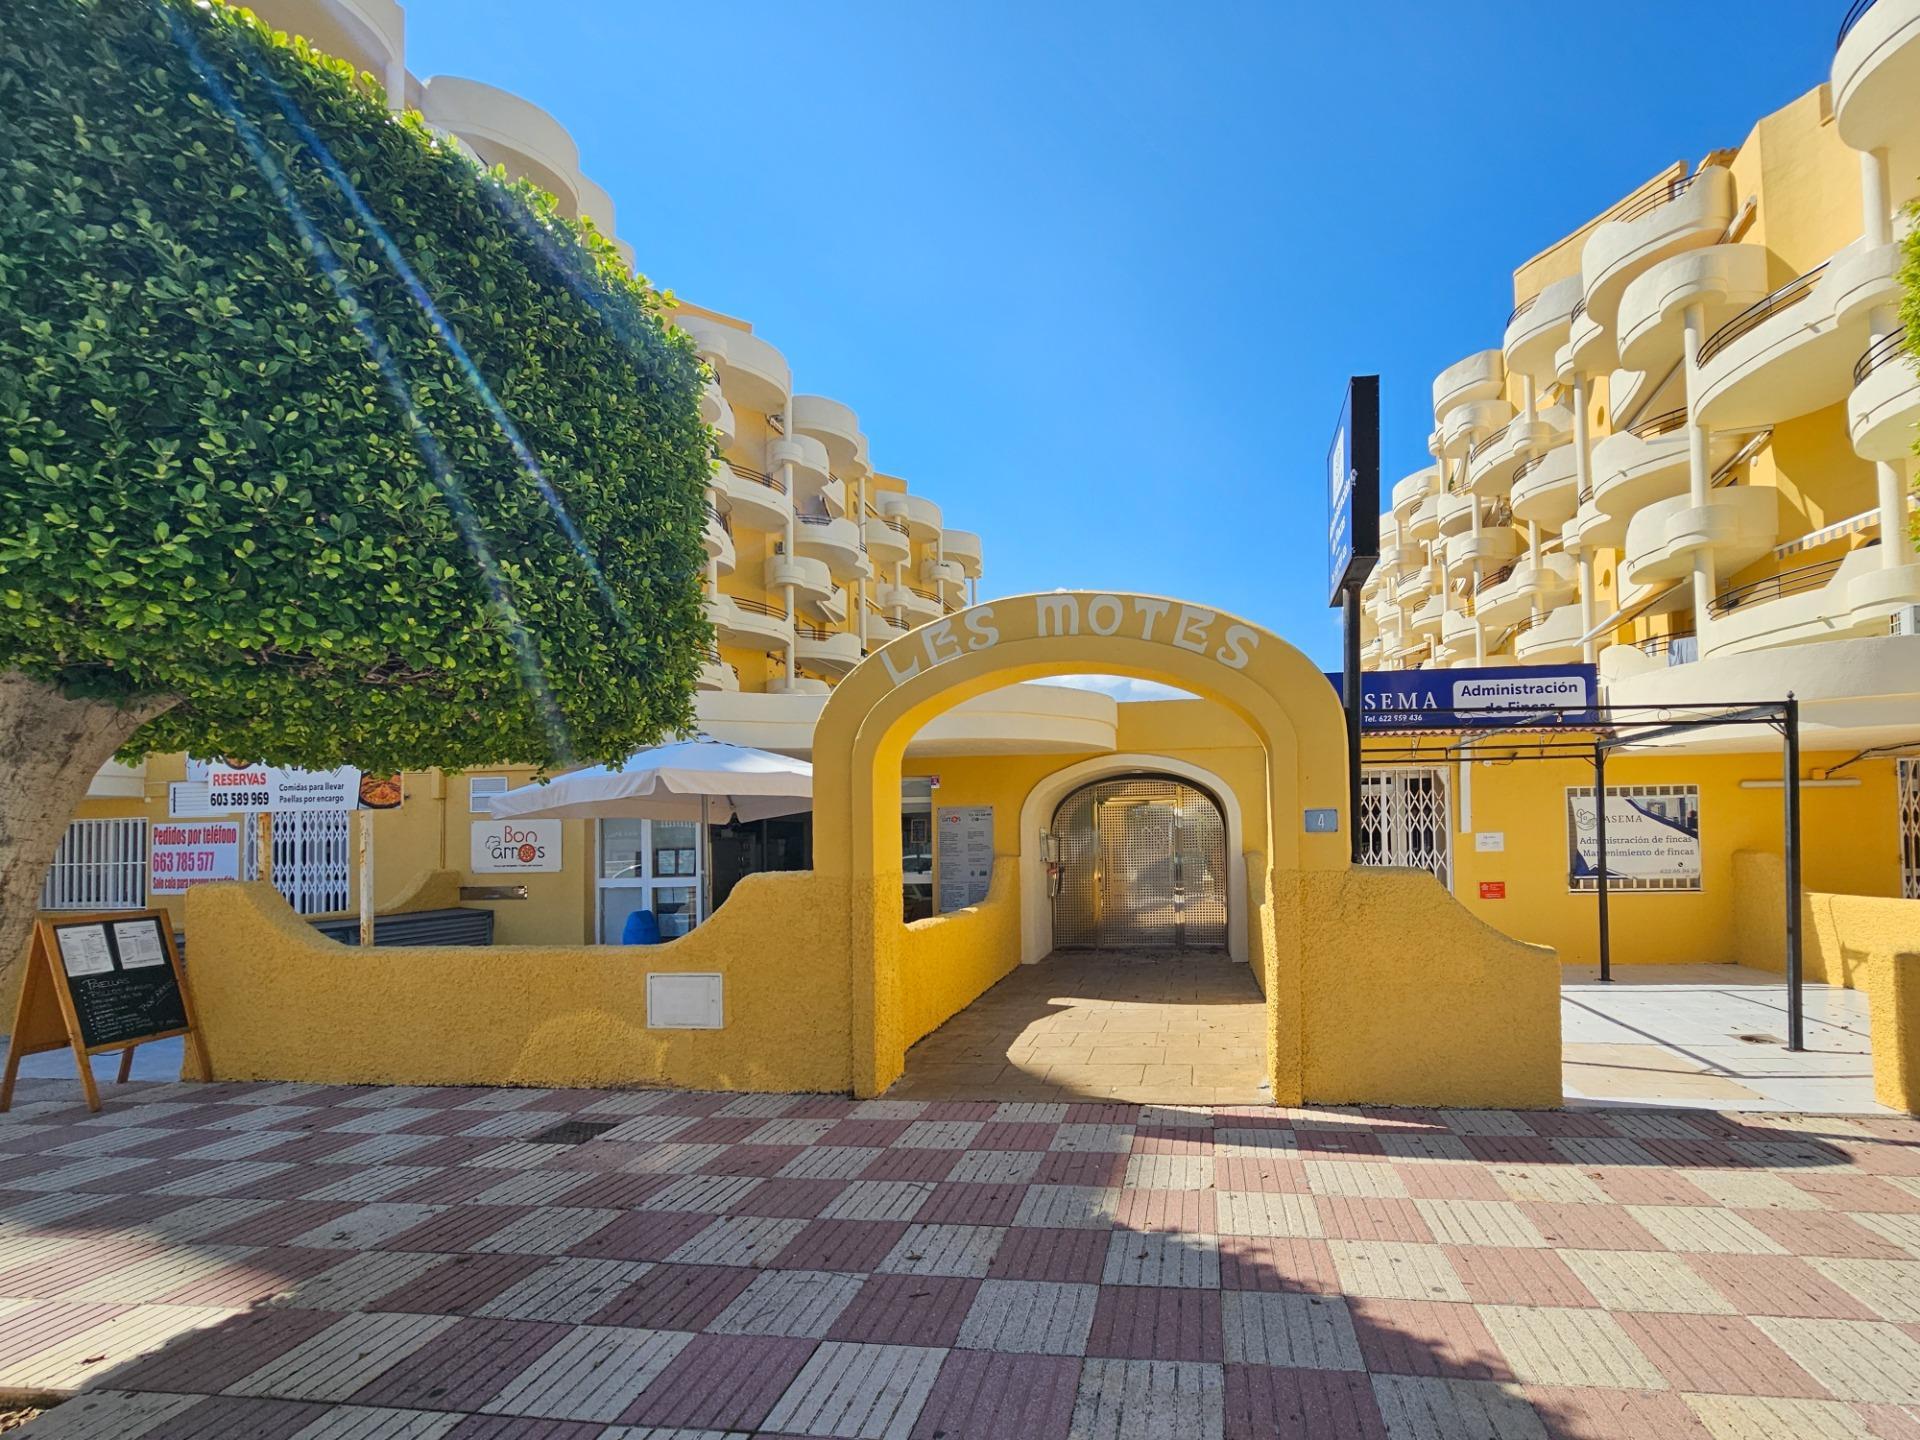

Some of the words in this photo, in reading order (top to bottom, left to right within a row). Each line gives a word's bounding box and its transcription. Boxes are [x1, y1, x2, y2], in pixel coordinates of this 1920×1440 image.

[879, 606, 1000, 685] LES
[1035, 594, 1260, 670] MOTES
[1461, 681, 1578, 697] Administración
[1364, 715, 1377, 723] Tel.
[1409, 714, 1423, 722] 436
[213, 772, 267, 786] RESERVAS
[279, 783, 308, 792] Comidas
[309, 785, 324, 793] para
[325, 783, 344, 791] llevar
[210, 792, 229, 806] 603
[231, 792, 249, 806] 589
[251, 791, 269, 805] 969
[279, 795, 303, 803] Paellas
[303, 796, 316, 804] por
[317, 795, 344, 804] encargo
[1318, 813, 1325, 829] 4
[1605, 815, 1643, 823] ASEMA
[153, 826, 186, 845] Pedidos
[188, 829, 201, 847] por
[203, 824, 237, 844] teléfono
[504, 825, 538, 843] Bon
[1580, 835, 1650, 844] Admnistración
[1652, 835, 1663, 843] de
[1666, 834, 1693, 843] fincas
[1583, 848, 1651, 857] Maenimiento
[1654, 848, 1664, 856] de
[1667, 847, 1694, 856] fincas
[153, 851, 173, 872] 663
[176, 851, 195, 872] 785
[197, 851, 215, 872] 577
